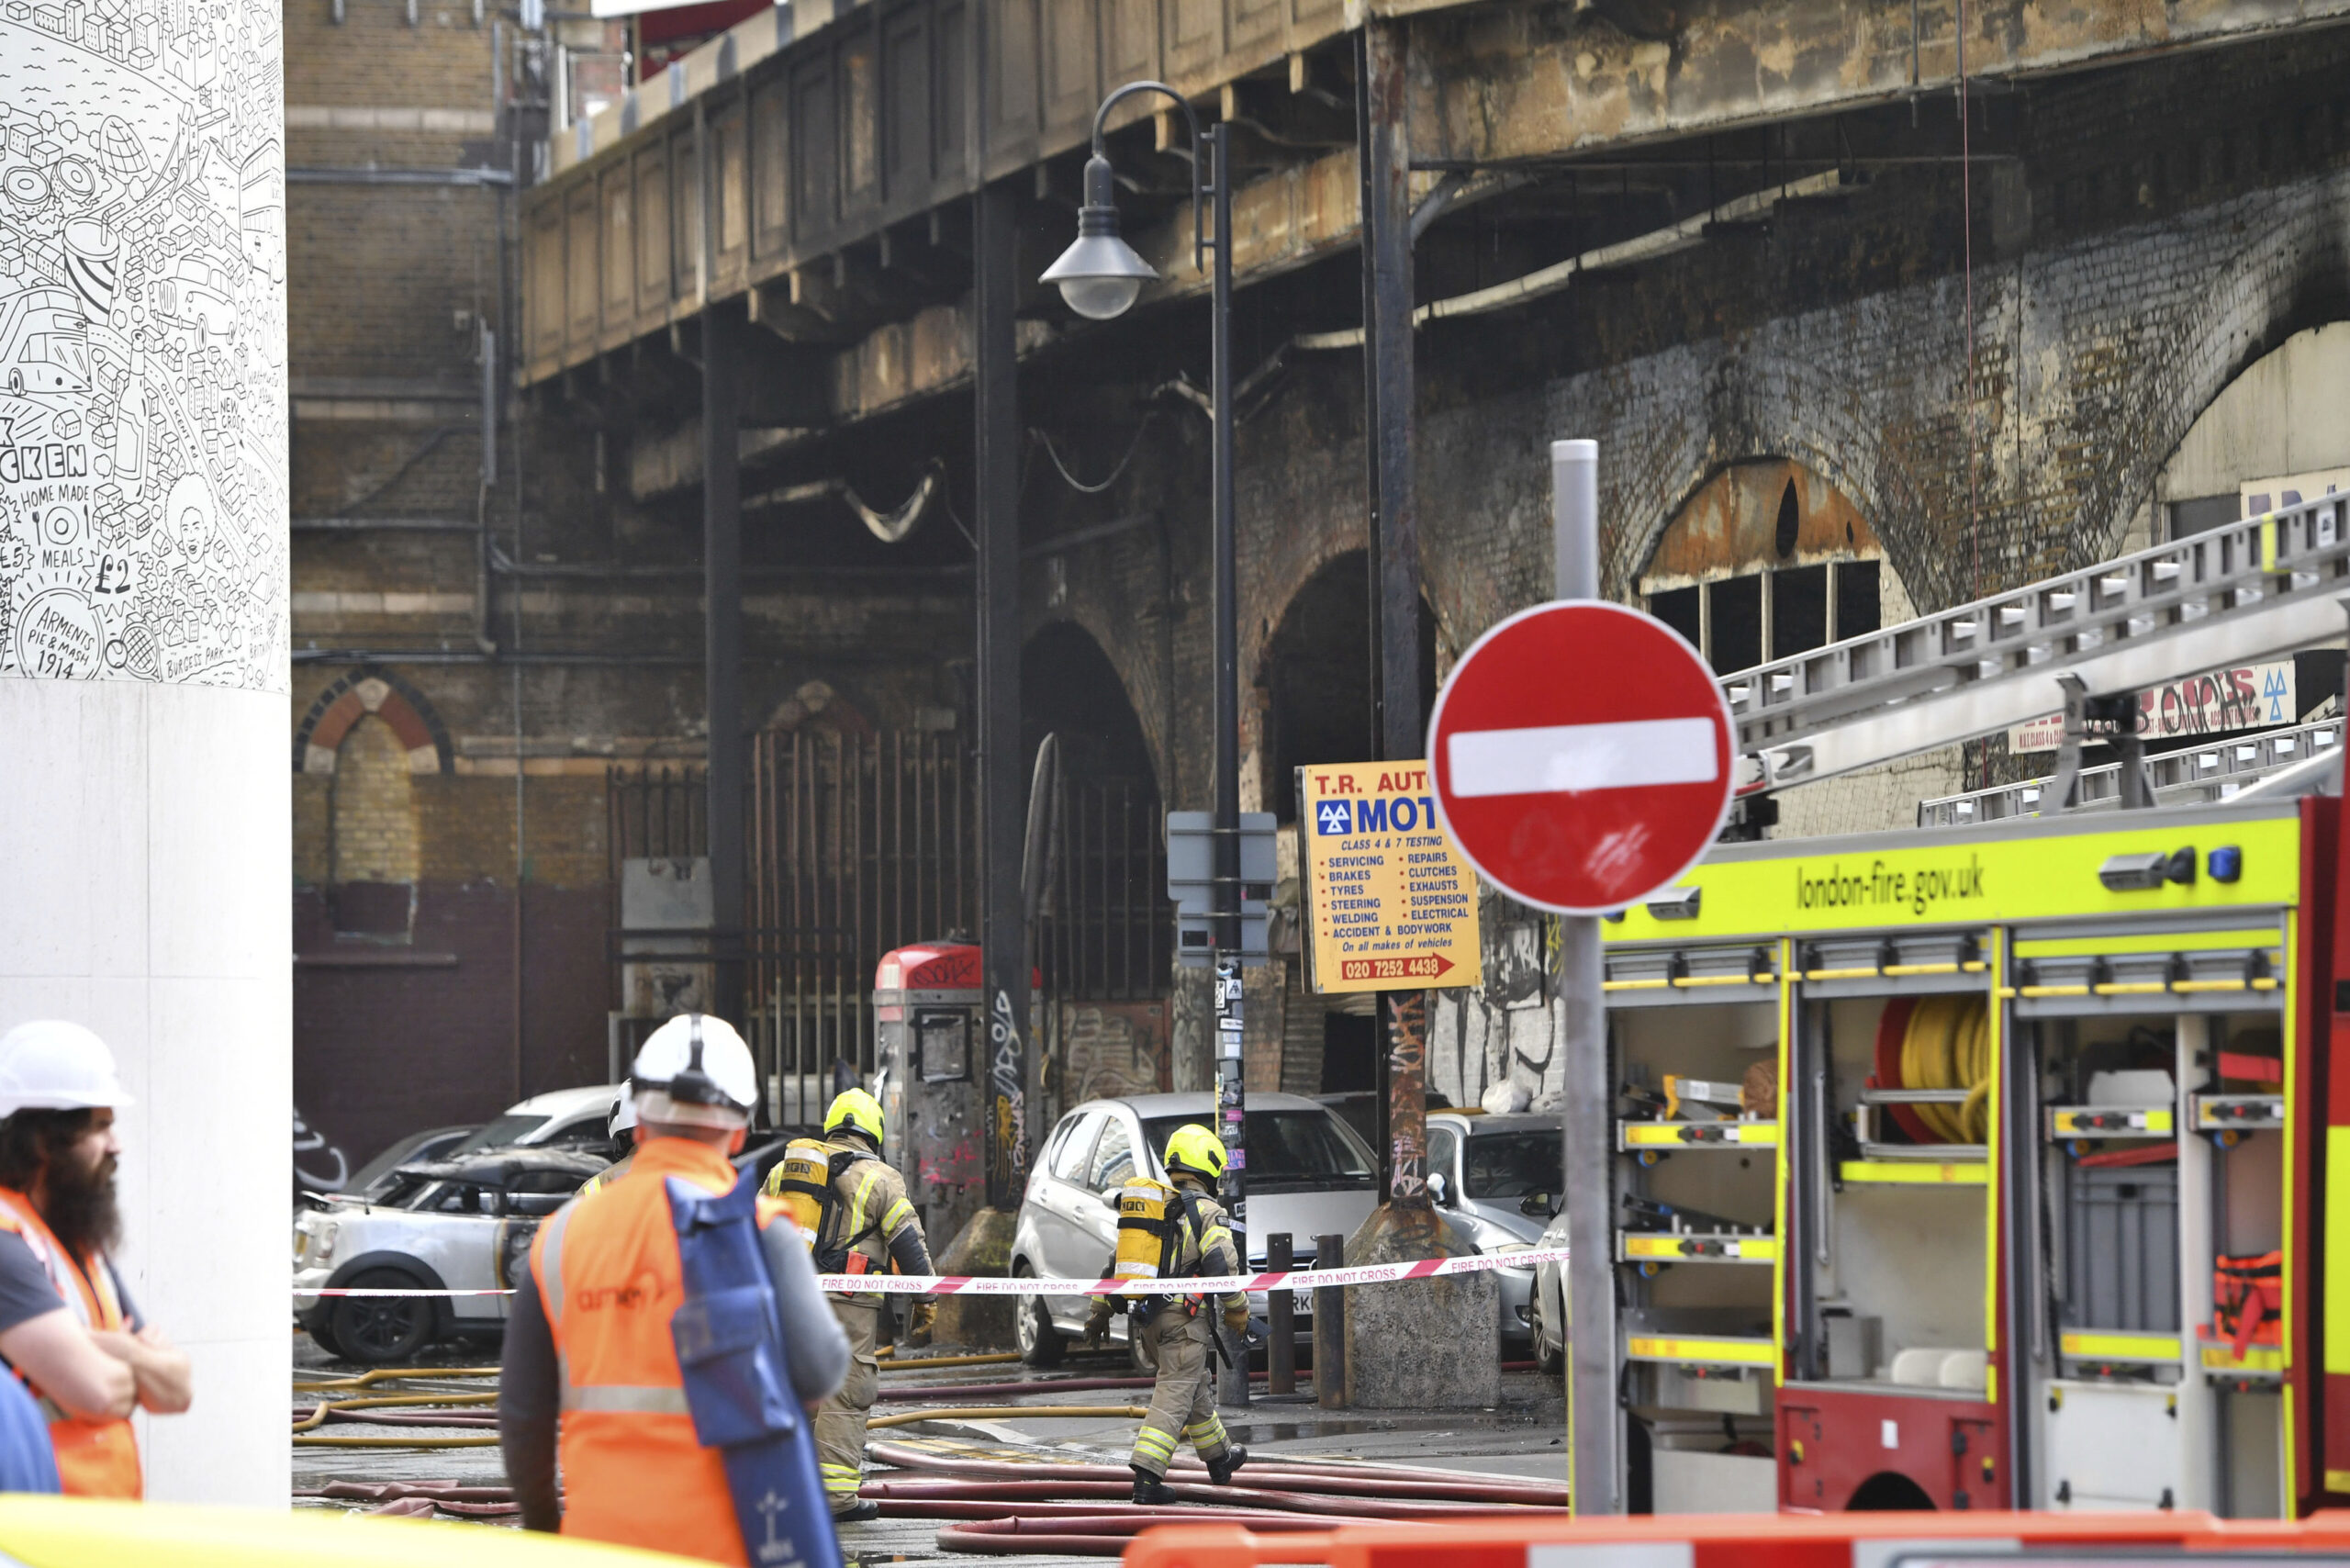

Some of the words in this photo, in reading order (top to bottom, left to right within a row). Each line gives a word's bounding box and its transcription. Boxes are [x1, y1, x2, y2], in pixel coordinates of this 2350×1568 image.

[210, 4, 227, 20] END
[161, 383, 174, 406] OLD
[173, 409, 191, 440] KENT
[220, 398, 239, 415] NEW
[221, 414, 246, 433] CROSS
[21, 484, 54, 512] HOME
[58, 483, 90, 503] MADE
[0, 546, 24, 569] £5
[42, 546, 84, 568] MEALS
[95, 554, 131, 595] £2
[37, 606, 95, 651] ARMENTS
[28, 629, 48, 645] PIE
[48, 636, 58, 649] &
[57, 641, 89, 666] MASH
[38, 650, 74, 679] 1914
[166, 653, 202, 678] BURGESS
[204, 646, 224, 666] PARK
[1315, 775, 1362, 795] T.R.
[1377, 770, 1431, 792] AUT
[1341, 838, 1371, 851] CLASS
[1374, 838, 1381, 849] 4
[1385, 837, 1392, 849] &
[1396, 837, 1402, 848] 7
[1405, 835, 1442, 848] TESTING
[1328, 856, 1384, 868] SERVICING
[1407, 852, 1448, 864] REPAIRS
[1329, 869, 1371, 882] BRAKES
[1408, 866, 1458, 879] CLUTCHES
[1330, 884, 1364, 897] TYRES
[1409, 879, 1459, 892] EXHAUSTS
[1796, 853, 1985, 915] london-fire.gov.uk
[1331, 898, 1381, 911] STEERING
[1410, 893, 1469, 907] SUSPENSION
[1331, 912, 1379, 924] WELDING
[1411, 907, 1469, 920] ELECTRICAL
[1333, 925, 1381, 938] ACCIDENT
[1384, 925, 1392, 936] &
[1342, 941, 1354, 953] On
[1358, 941, 1369, 952] all
[1371, 939, 1401, 951] makes
[1404, 938, 1415, 949] of
[1417, 936, 1452, 948] vehicles
[1346, 961, 1371, 979] 020
[1375, 959, 1404, 977] 7252
[1408, 958, 1439, 975] 4438
[1451, 1260, 1474, 1273] FIRE
[1477, 1259, 1493, 1271] DO
[1495, 1256, 1516, 1269] NOT
[1520, 1252, 1557, 1266] CROSS
[822, 1278, 845, 1290] FIRE
[846, 1279, 862, 1290] DO
[864, 1280, 885, 1291] NOT
[887, 1281, 923, 1291] CROSS
[1292, 1275, 1315, 1286] FIRE
[1317, 1273, 1333, 1284] DO
[1336, 1271, 1357, 1282] NOT
[1360, 1268, 1396, 1282] CROSS
